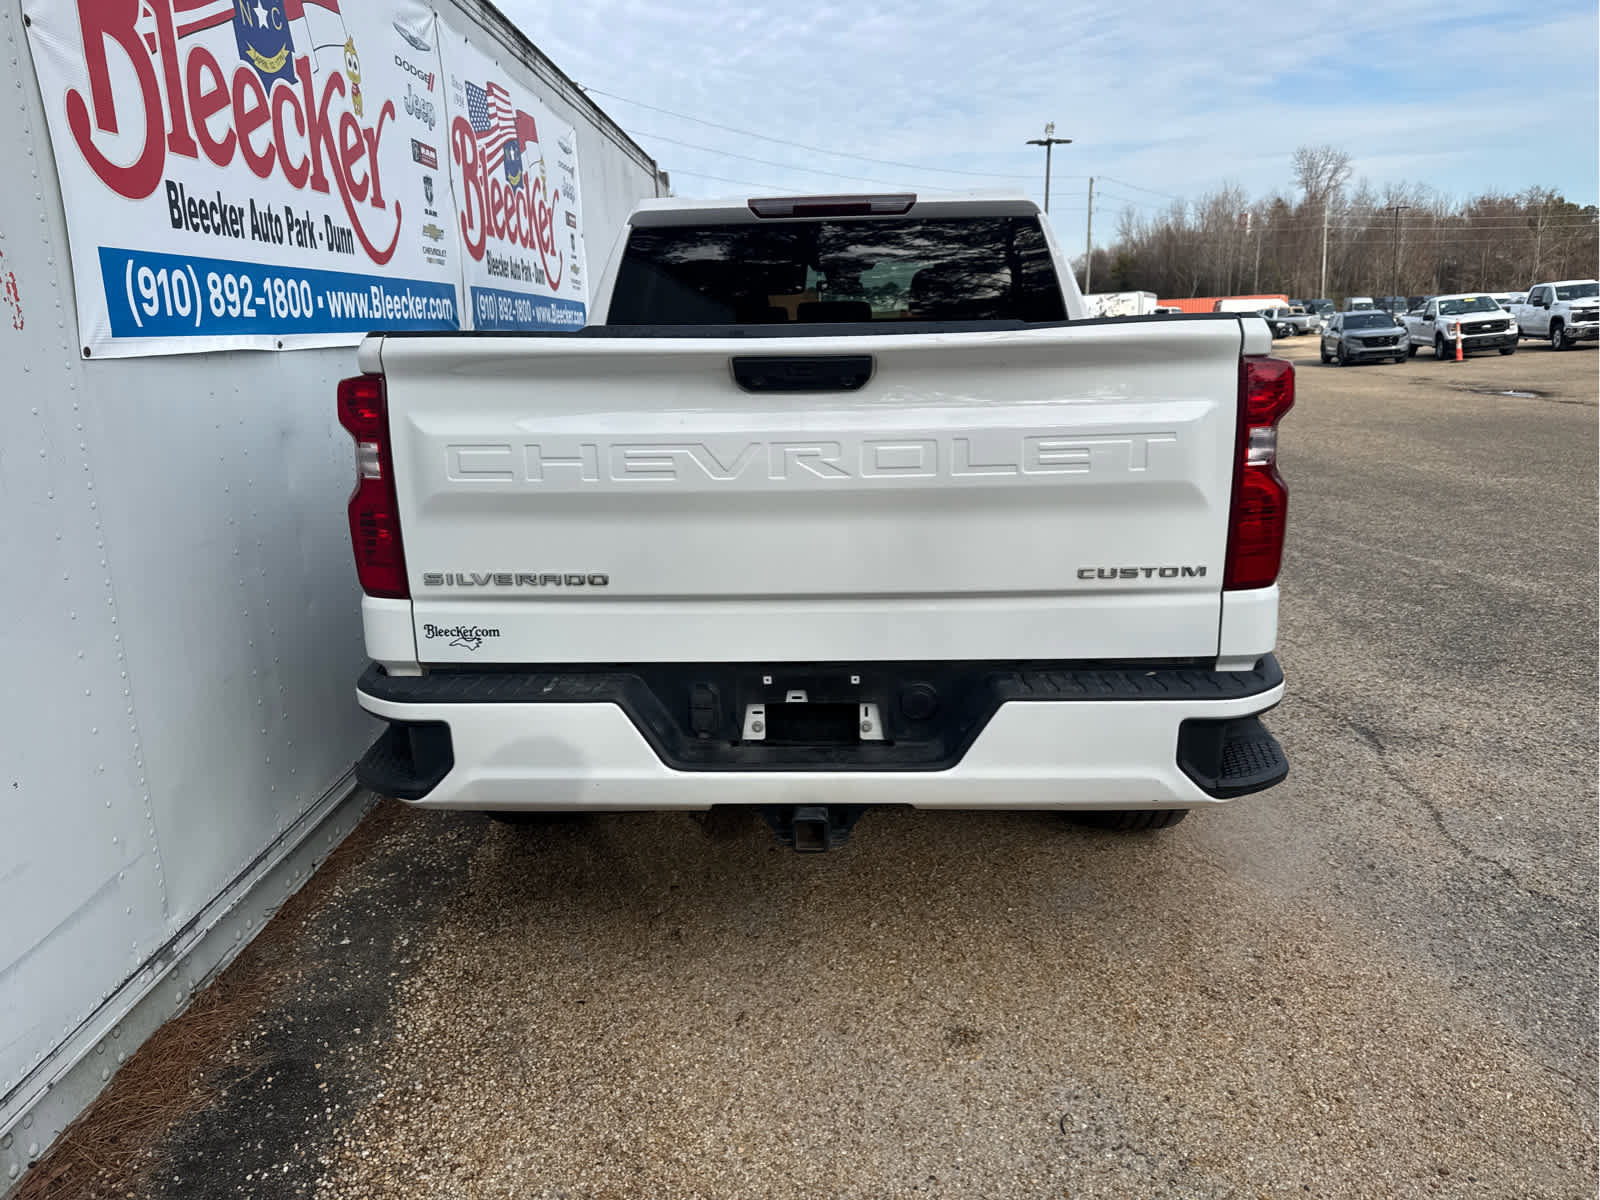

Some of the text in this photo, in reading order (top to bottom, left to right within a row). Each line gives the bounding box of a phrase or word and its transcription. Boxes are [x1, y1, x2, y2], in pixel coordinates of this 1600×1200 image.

[394, 54, 430, 85] DODGE
[403, 83, 436, 132] Jeep
[164, 179, 355, 256] Bleecker Auto Park Dunn
[423, 207, 439, 217] RAM
[452, 115, 563, 292] Bleecker
[486, 249, 546, 286] Bleecker Auto Park Dunn
[125, 258, 454, 328] (910) 892-1800 www.Bleecker.com
[476, 289, 499, 327] (910)
[498, 296, 533, 323] 892-1800
[446, 431, 1178, 482] CHEVROLET
[423, 572, 610, 587] SILVERADO
[1076, 565, 1208, 580] CUSTOM
